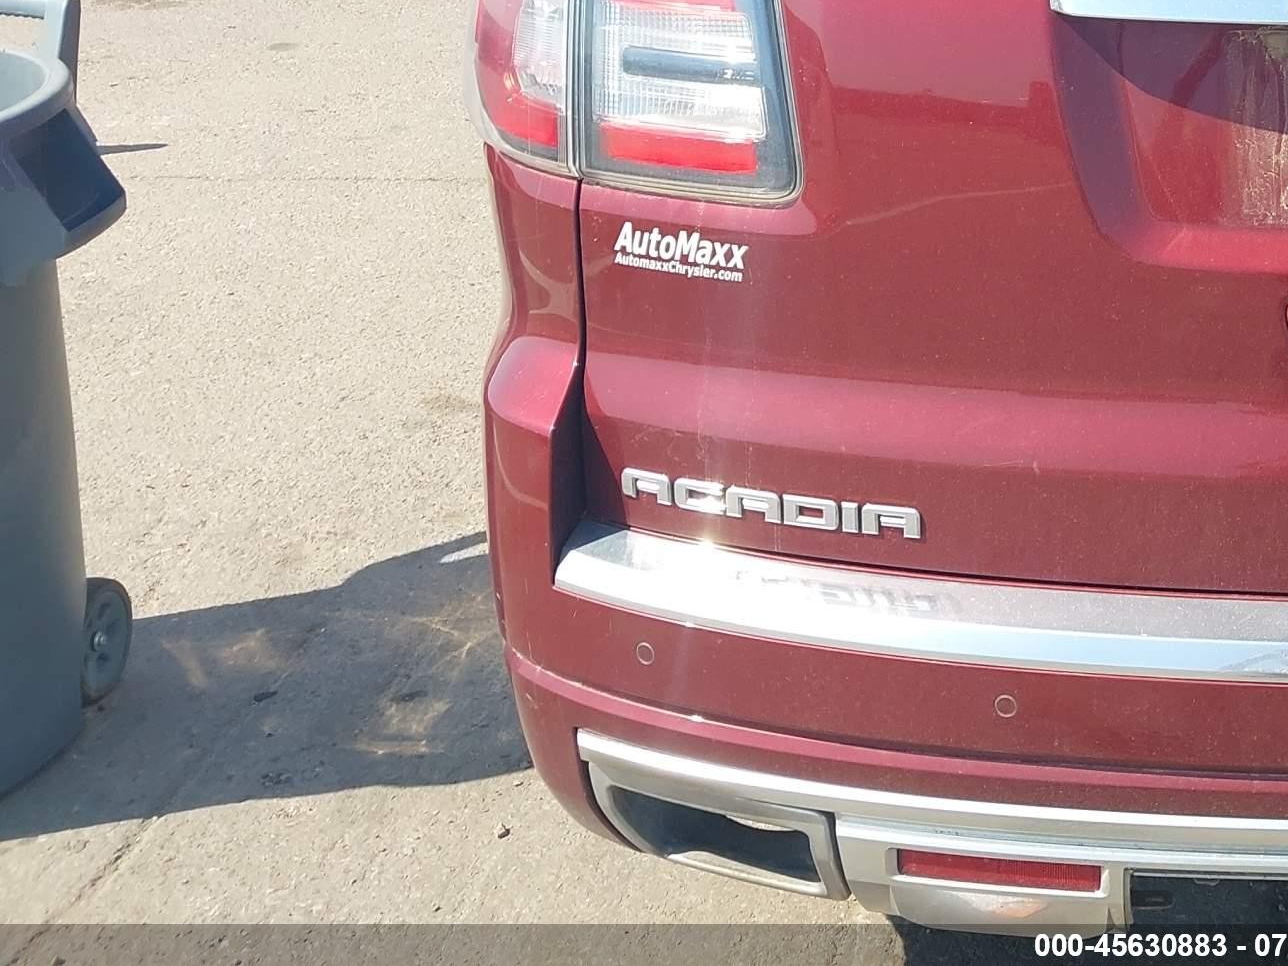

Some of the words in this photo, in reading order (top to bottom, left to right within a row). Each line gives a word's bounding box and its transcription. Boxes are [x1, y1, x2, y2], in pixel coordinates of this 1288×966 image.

[614, 221, 749, 270] AutoMaxx
[614, 252, 743, 283] AutomaxxChrysler.com
[621, 467, 922, 539] ACADIA
